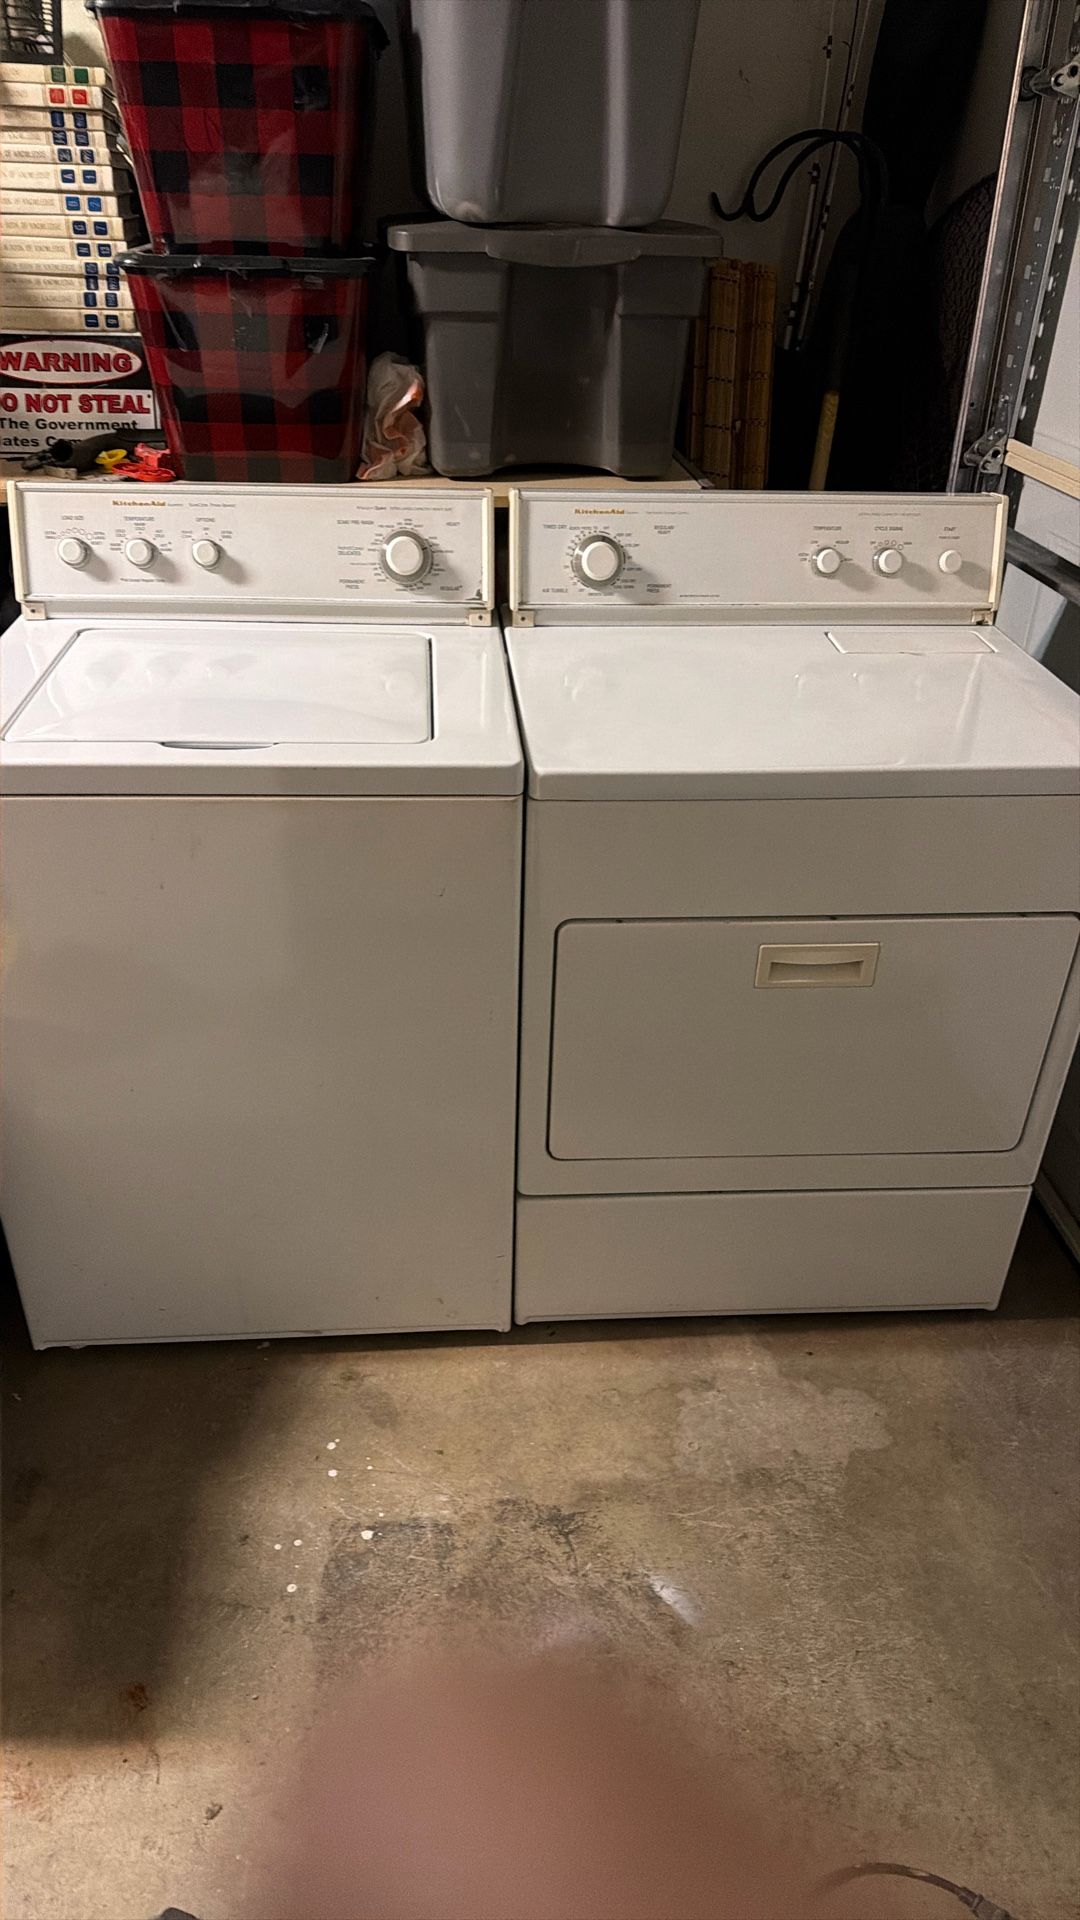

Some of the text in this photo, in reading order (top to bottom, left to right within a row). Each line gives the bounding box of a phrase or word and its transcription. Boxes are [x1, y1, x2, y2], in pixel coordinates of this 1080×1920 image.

[0, 351, 133, 373] WARNING
[24, 393, 73, 413] NOT
[78, 393, 152, 414] STEAL
[0, 417, 138, 431] The Government
